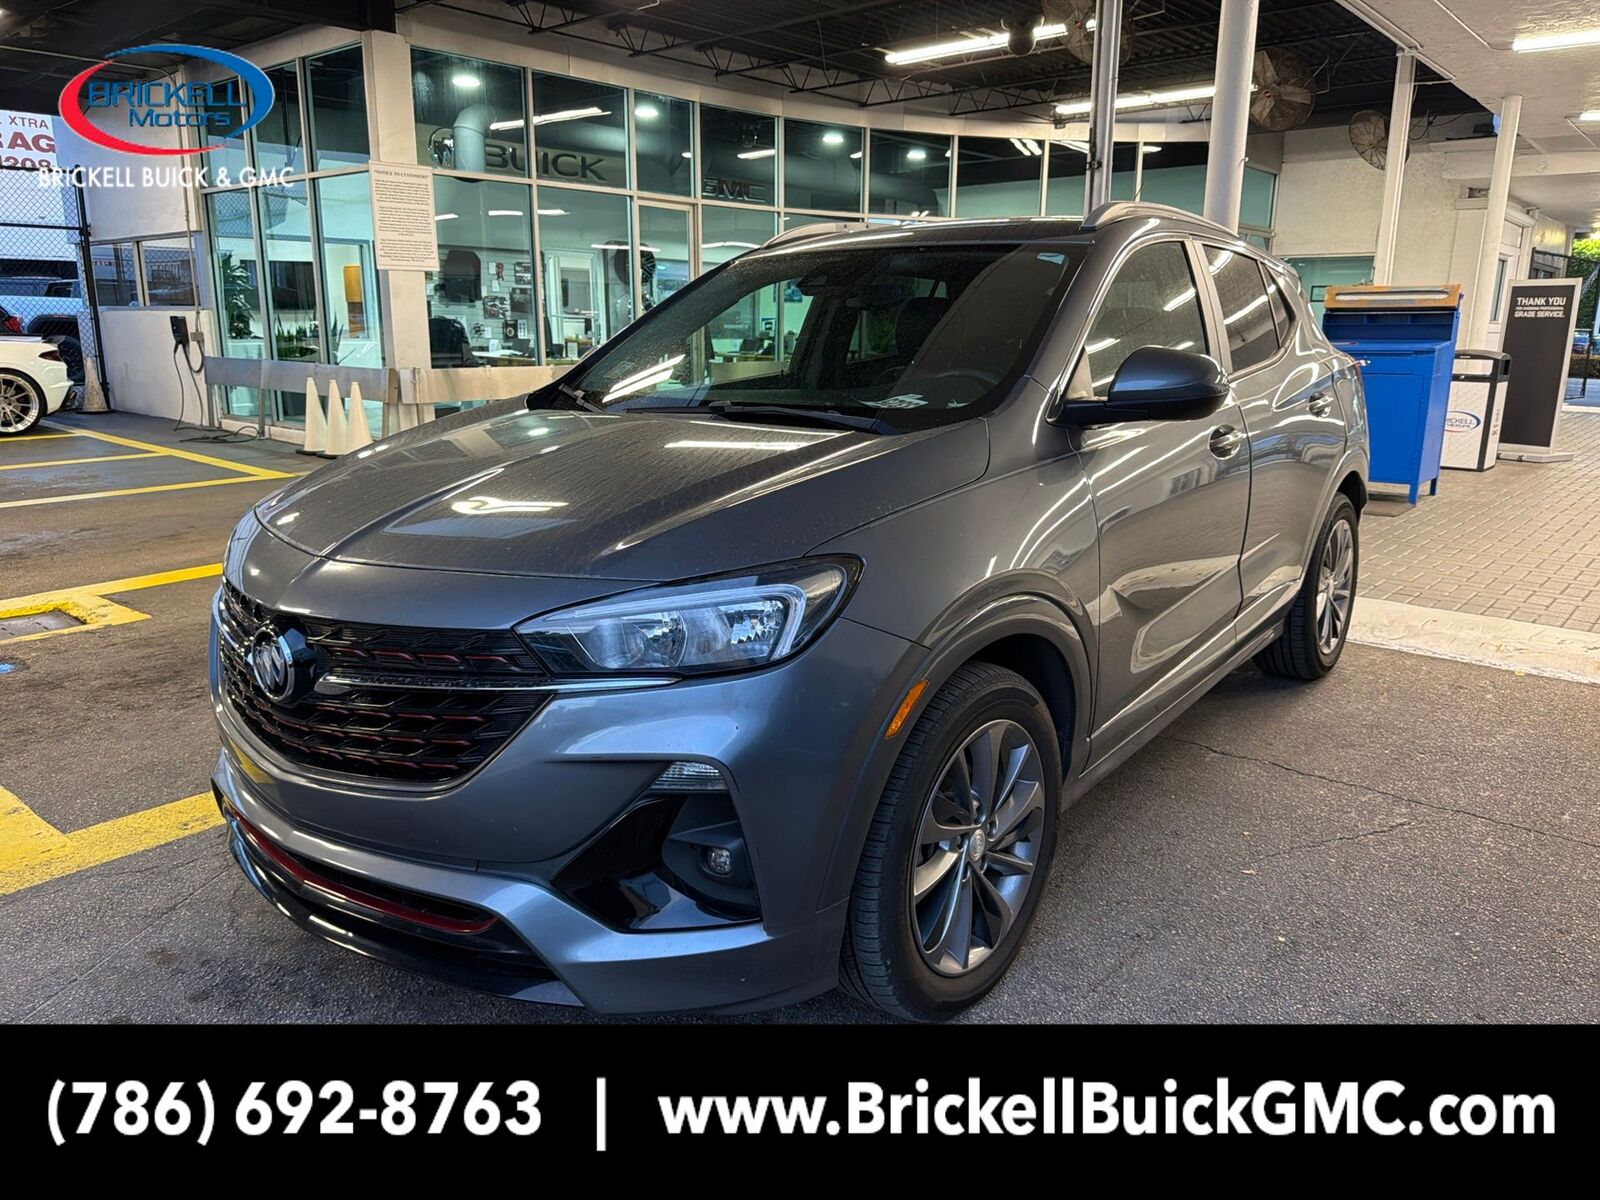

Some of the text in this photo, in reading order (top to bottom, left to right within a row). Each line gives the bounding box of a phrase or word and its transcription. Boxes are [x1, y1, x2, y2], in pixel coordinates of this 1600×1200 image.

[8, 115, 49, 130] XTRA
[0, 131, 56, 154] AG
[485, 143, 608, 182] BUICK
[1516, 296, 1567, 306] THANK YOU
[1514, 310, 1566, 318] GRADE SERVICE.
